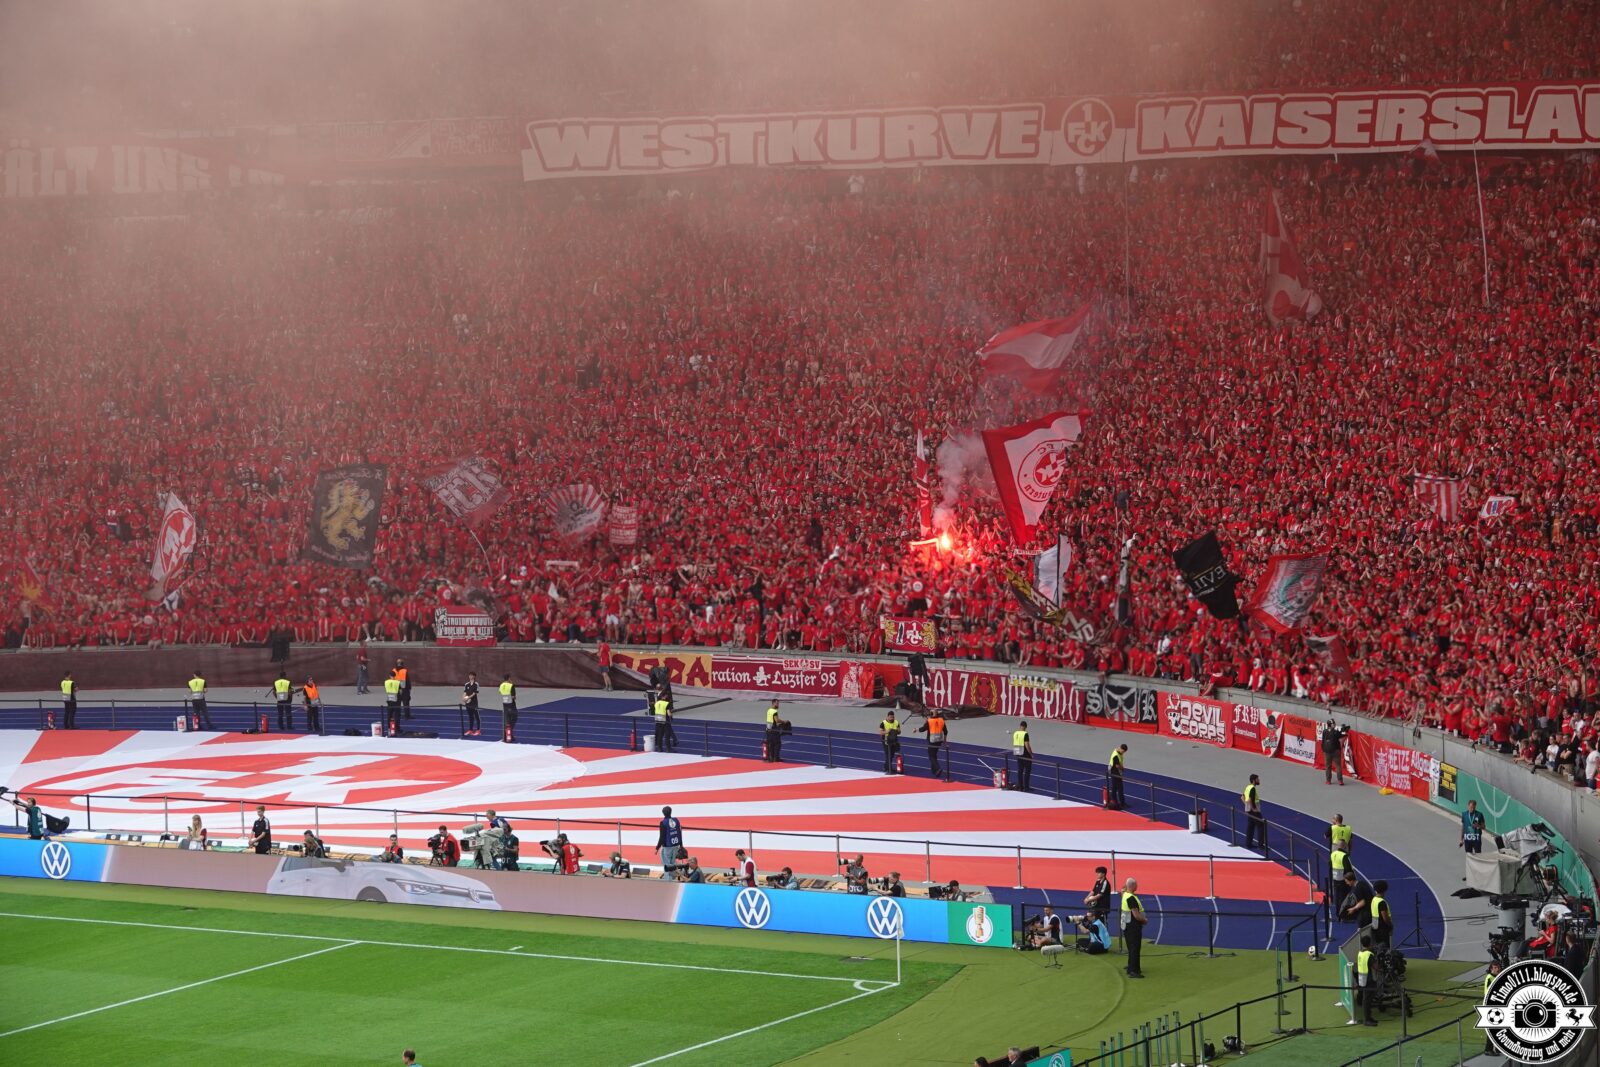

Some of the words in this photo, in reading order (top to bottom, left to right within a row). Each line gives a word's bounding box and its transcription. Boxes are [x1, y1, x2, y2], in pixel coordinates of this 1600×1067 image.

[532, 108, 1040, 168] WESTKURVE
[0, 139, 98, 197] ÄLT
[784, 660, 799, 668] SEK
[810, 661, 820, 669] SV
[735, 886, 771, 929] VW
